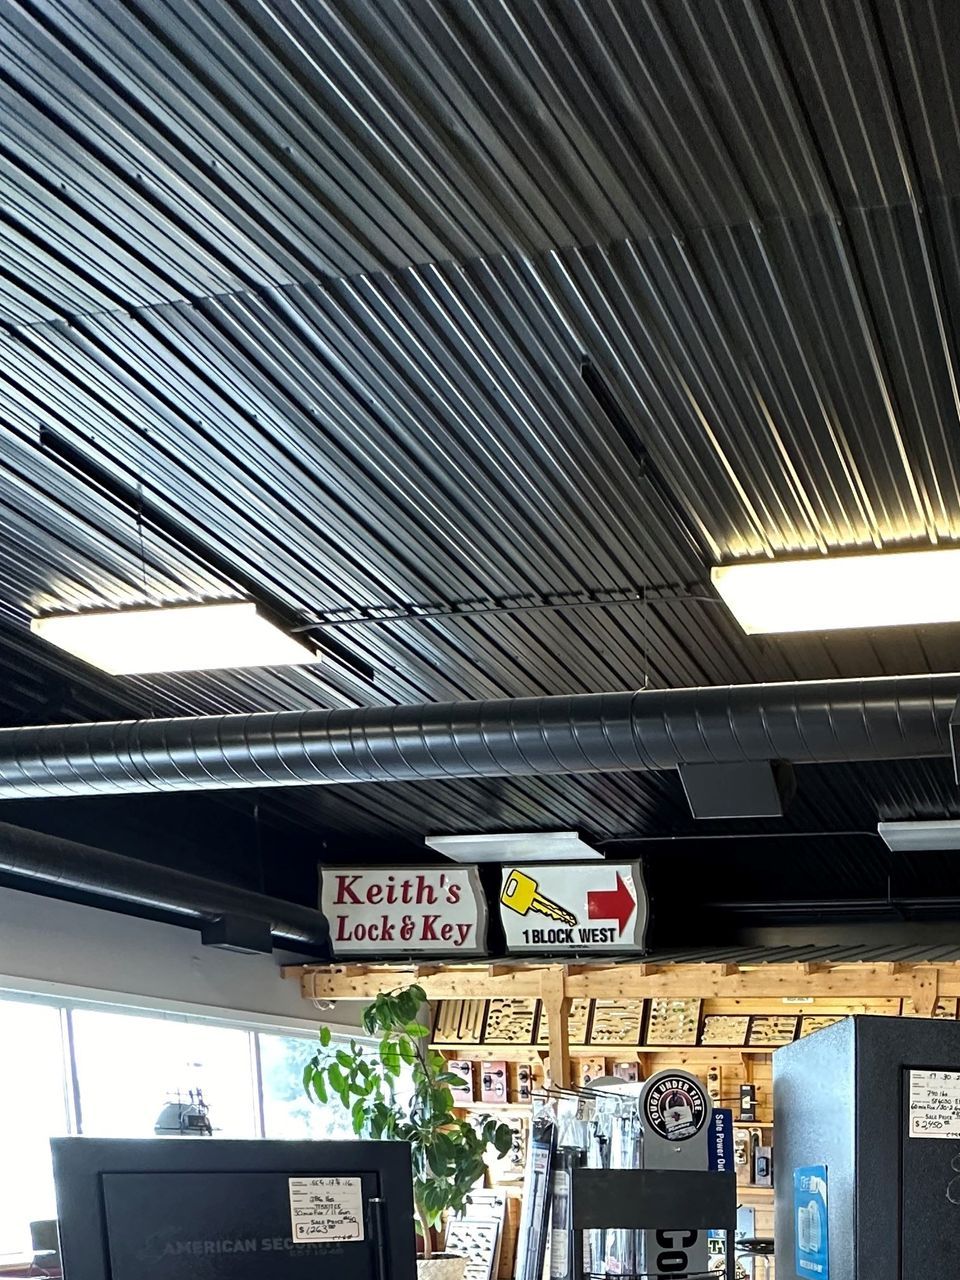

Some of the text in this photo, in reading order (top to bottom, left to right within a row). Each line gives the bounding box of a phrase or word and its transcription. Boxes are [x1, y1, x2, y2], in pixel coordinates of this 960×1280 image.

[333, 873, 461, 905] Keith's
[335, 915, 473, 946] Lock & Key
[522, 928, 616, 943] 1 BLOCK WEST
[650, 1080, 702, 1125] TOUGH UNDER FIRE
[715, 1114, 724, 1132] Safe
[716, 1133, 724, 1158] Power
[164, 1239, 257, 1255] AMERICAN
